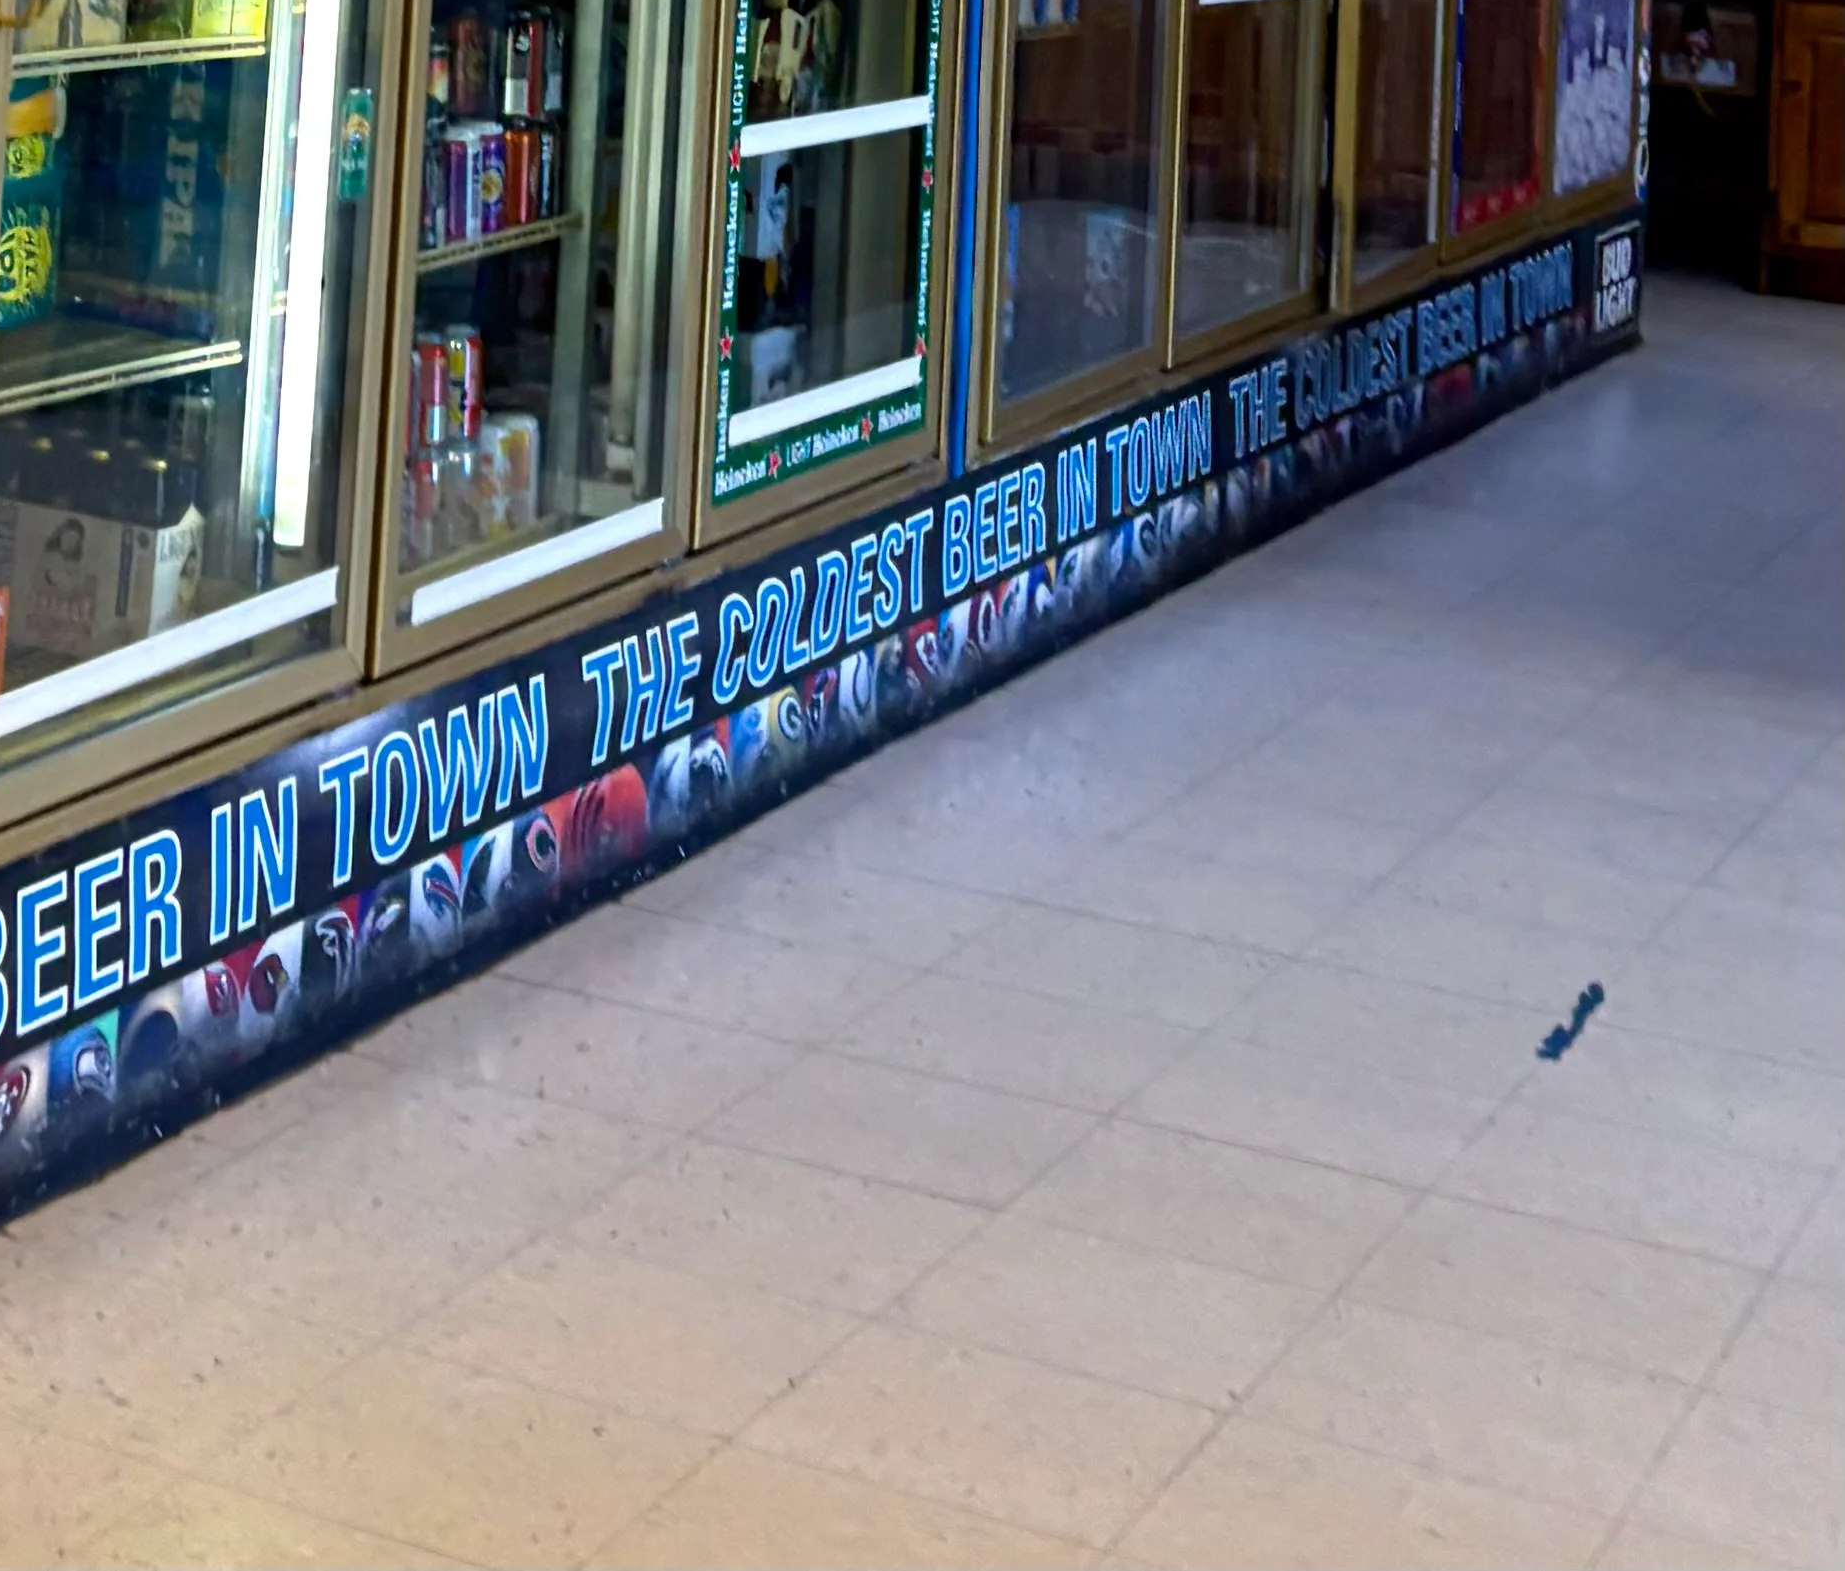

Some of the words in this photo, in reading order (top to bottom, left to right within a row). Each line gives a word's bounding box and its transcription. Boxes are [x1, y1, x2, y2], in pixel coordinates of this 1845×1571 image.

[731, 61, 745, 127] LIGHT
[721, 180, 738, 309] Heineken
[1600, 233, 1630, 287] BUD
[1593, 276, 1633, 334] LIGHT
[1228, 356, 1289, 455] THE
[1294, 306, 1412, 426] COLDEST
[1416, 282, 1478, 377] BEER
[1479, 270, 1507, 345] IN
[1509, 242, 1574, 329] TOWN
[812, 424, 859, 458] Heineken
[878, 402, 921, 432] Heineken
[715, 458, 767, 496] Heineken
[581, 610, 700, 766] THE
[710, 507, 934, 706] COLDEST
[942, 463, 1045, 599] BEER
[1055, 436, 1100, 541] IN
[1104, 388, 1214, 517] TOWN
[209, 777, 298, 946] IN
[320, 674, 549, 889] TOWN
